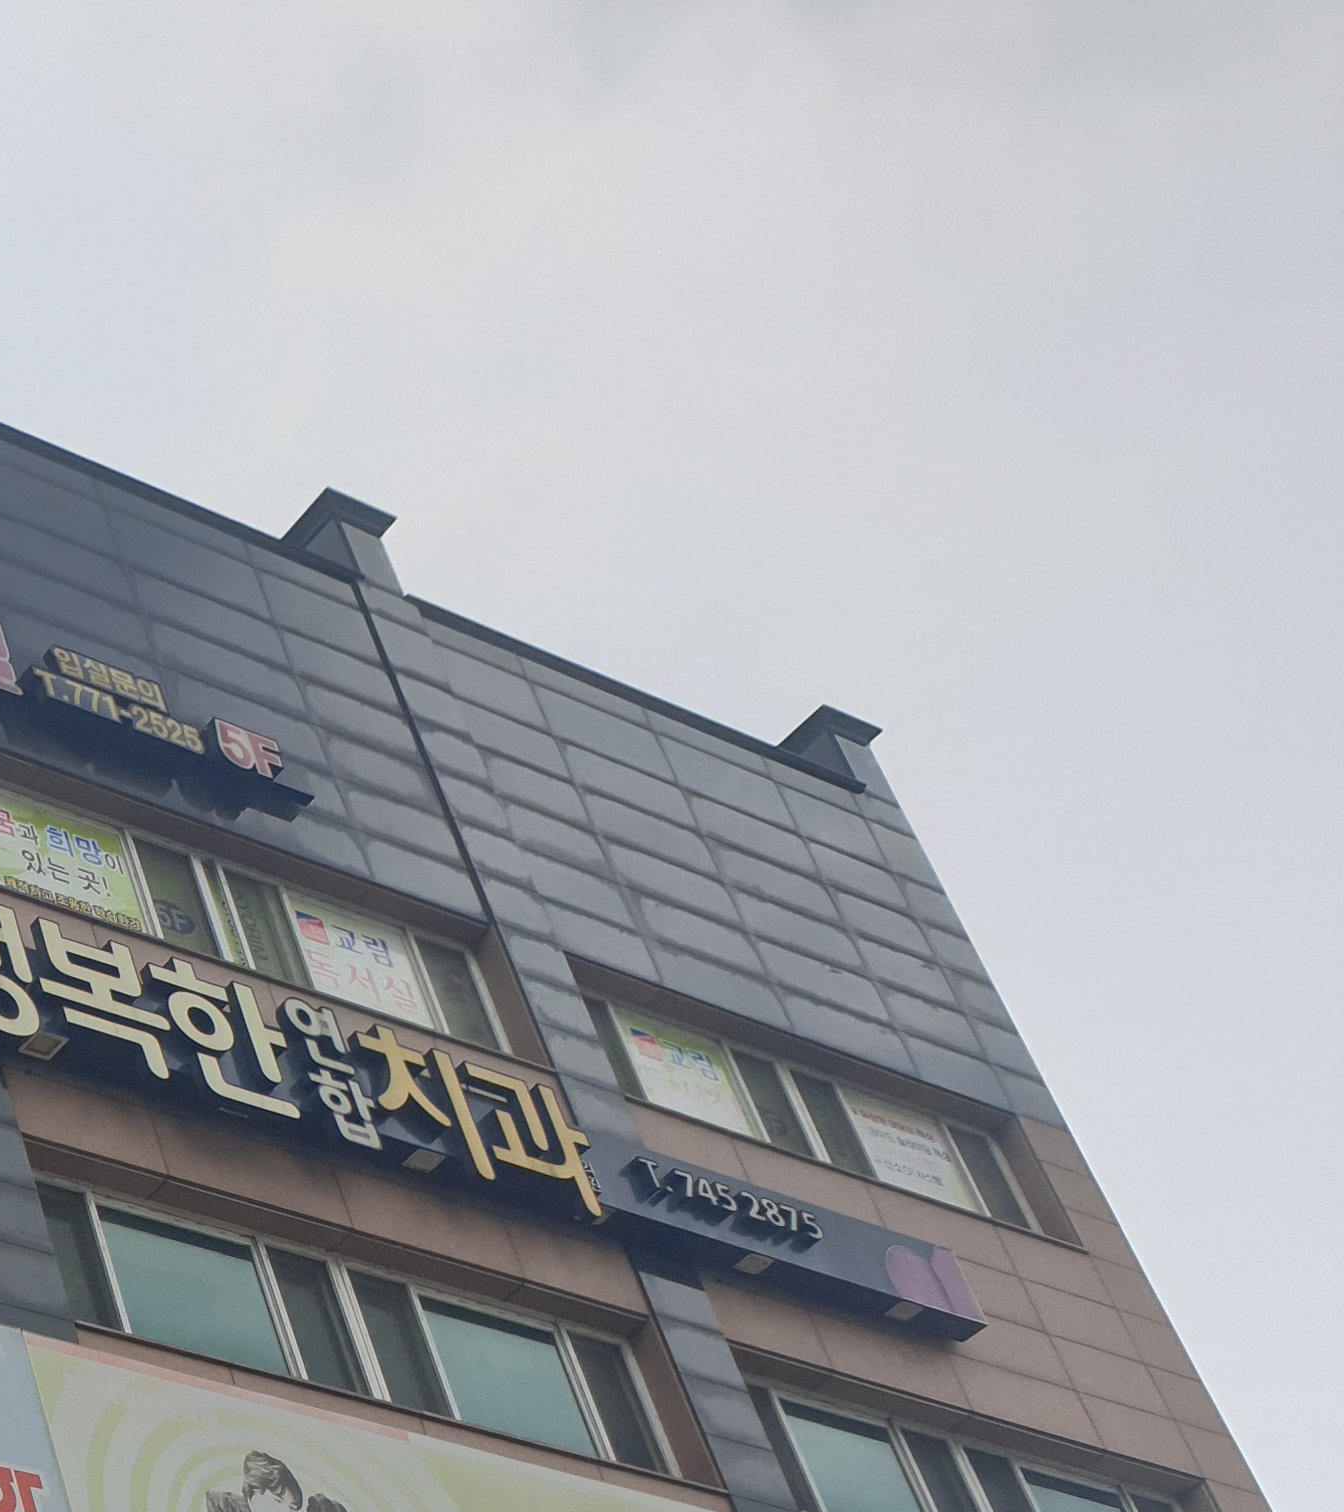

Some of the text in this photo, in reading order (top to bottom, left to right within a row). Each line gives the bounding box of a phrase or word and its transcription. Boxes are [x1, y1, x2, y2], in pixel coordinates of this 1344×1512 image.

[53, 646, 168, 713] 입실문의
[213, 717, 286, 781] 5F
[20, 849, 112, 898] 있는 곳!
[45, 826, 126, 876] 희망이
[330, 923, 395, 969] 교림
[282, 996, 384, 1152] 연합
[357, 1021, 604, 1218] 치과
